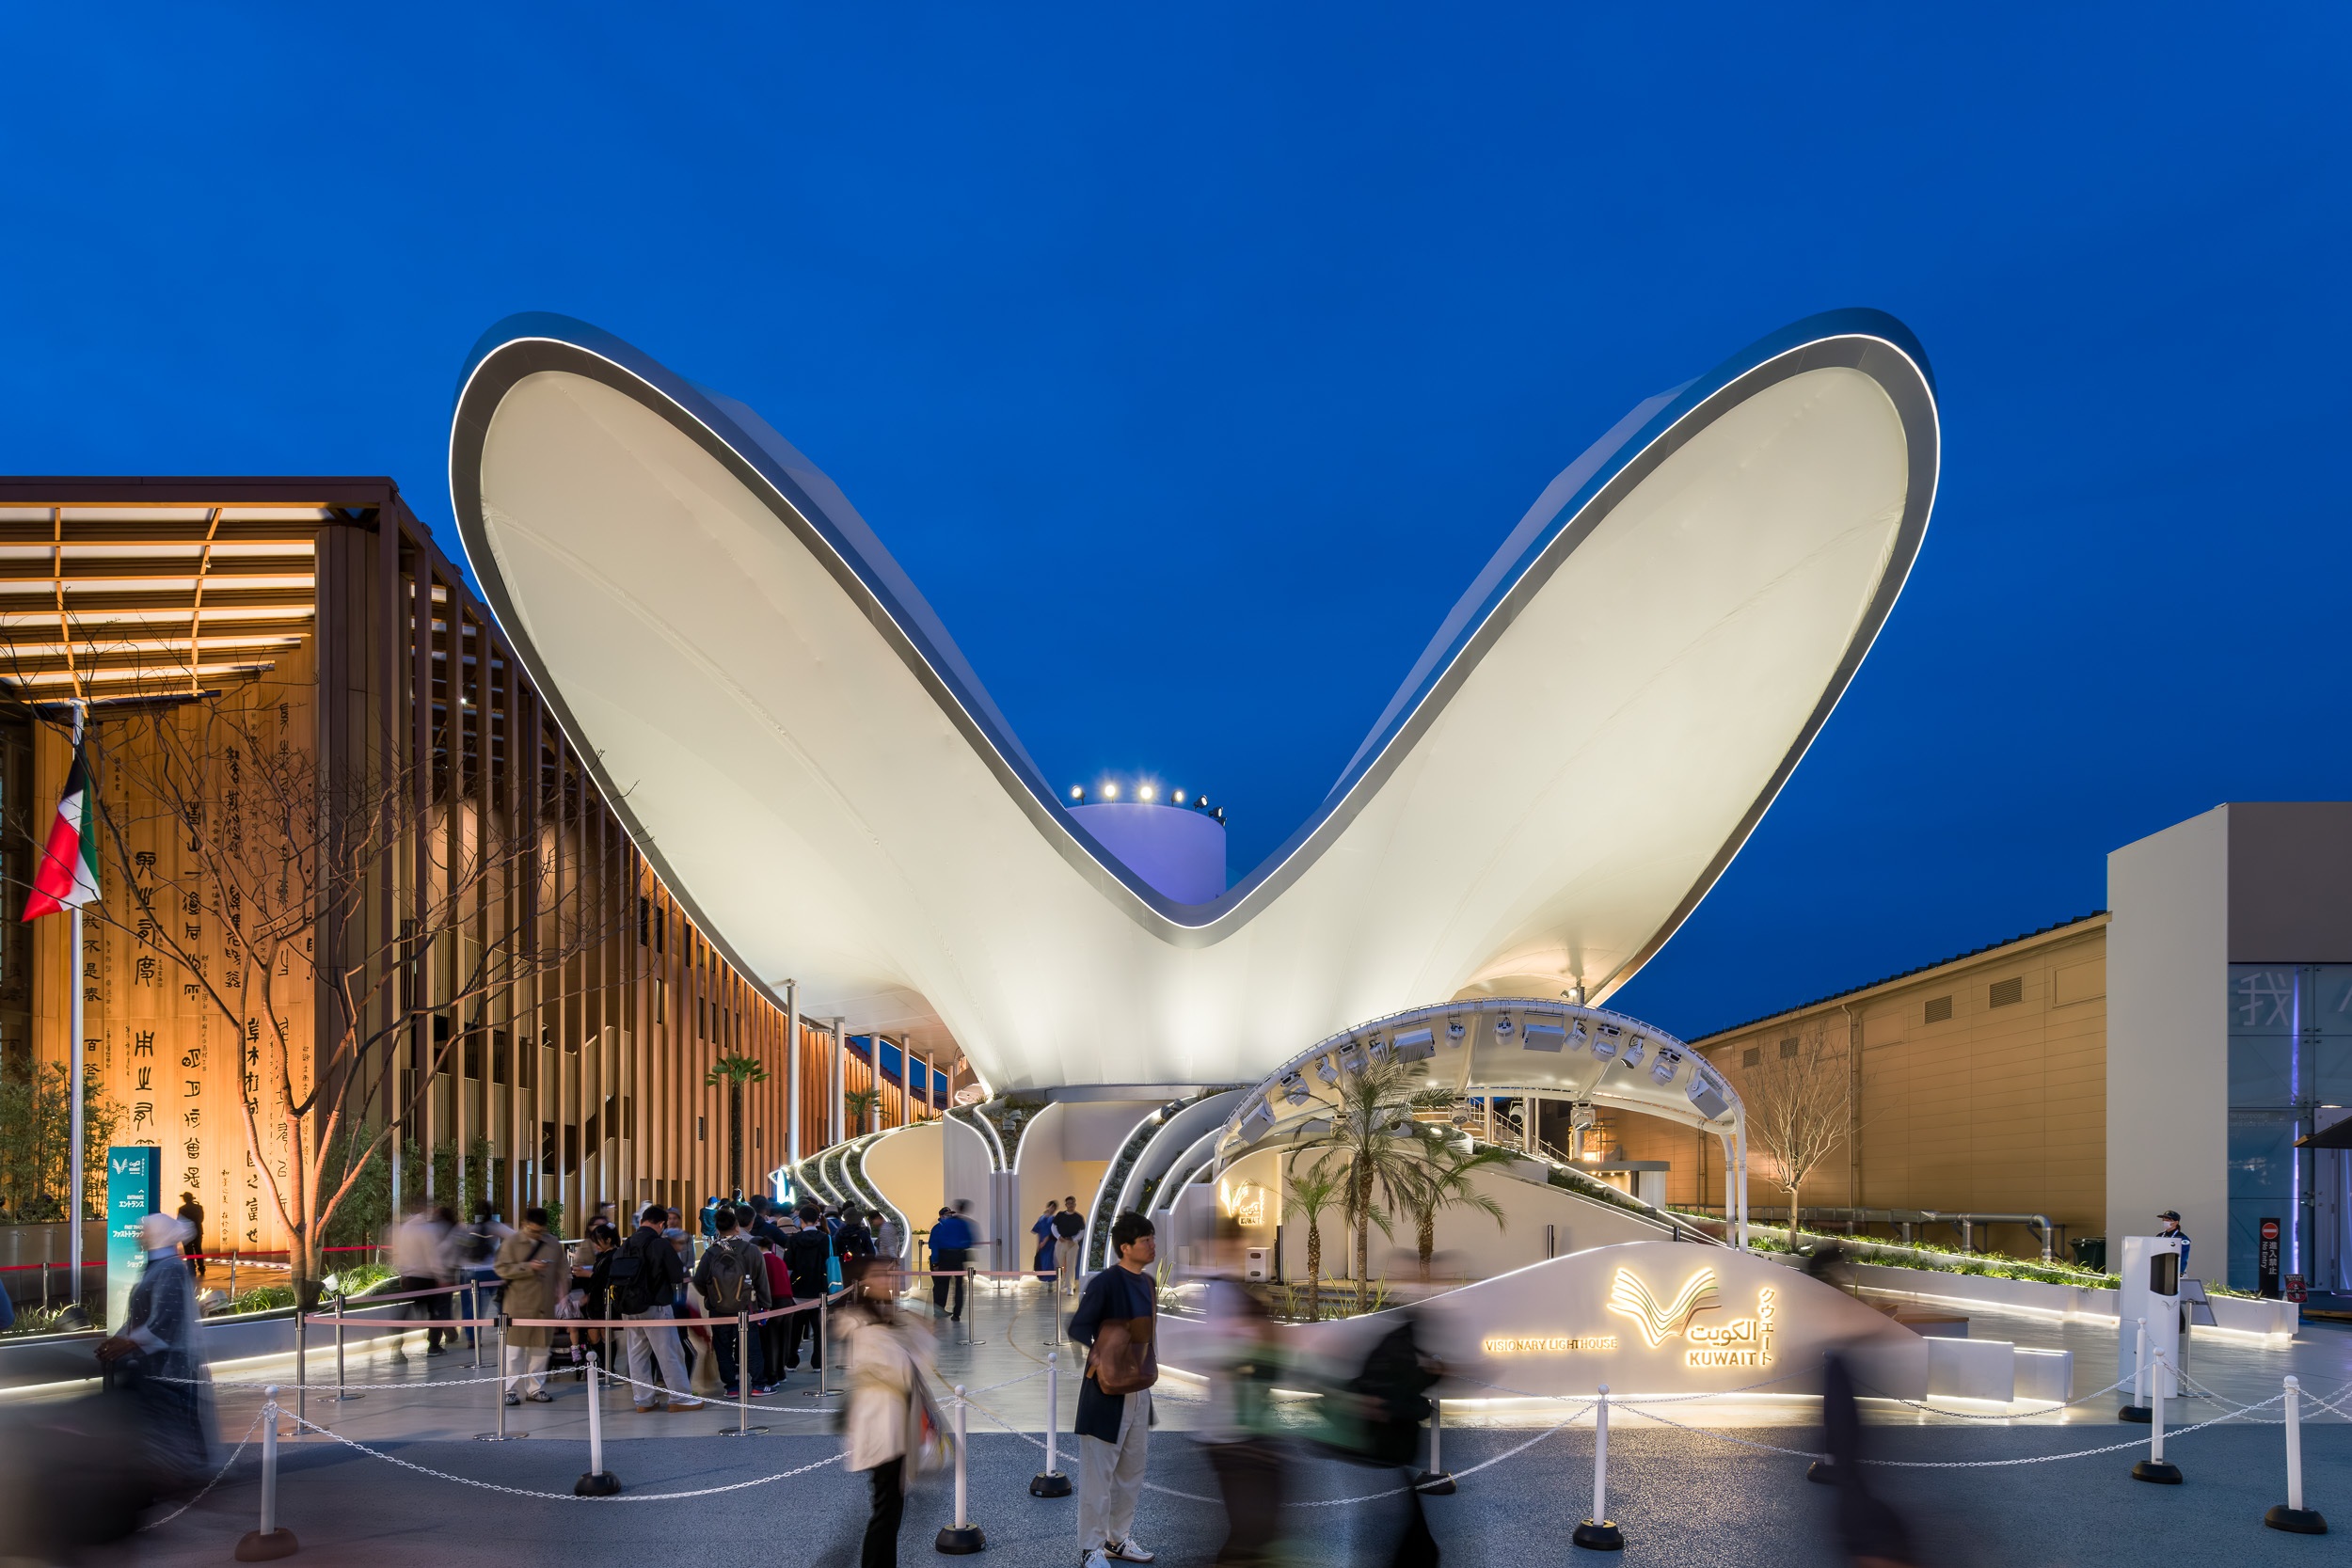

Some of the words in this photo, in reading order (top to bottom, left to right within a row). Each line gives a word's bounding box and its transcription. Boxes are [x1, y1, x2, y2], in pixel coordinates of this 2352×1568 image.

[2262, 1241, 2268, 1251] No
[2268, 1241, 2278, 1275] 進入禁止
[1691, 1321, 1757, 1346] الكويت
[1486, 1340, 1546, 1352] VISIONARY
[1549, 1338, 1618, 1350] LIGHTHOUSE
[1690, 1352, 1757, 1366] KUWAIT
